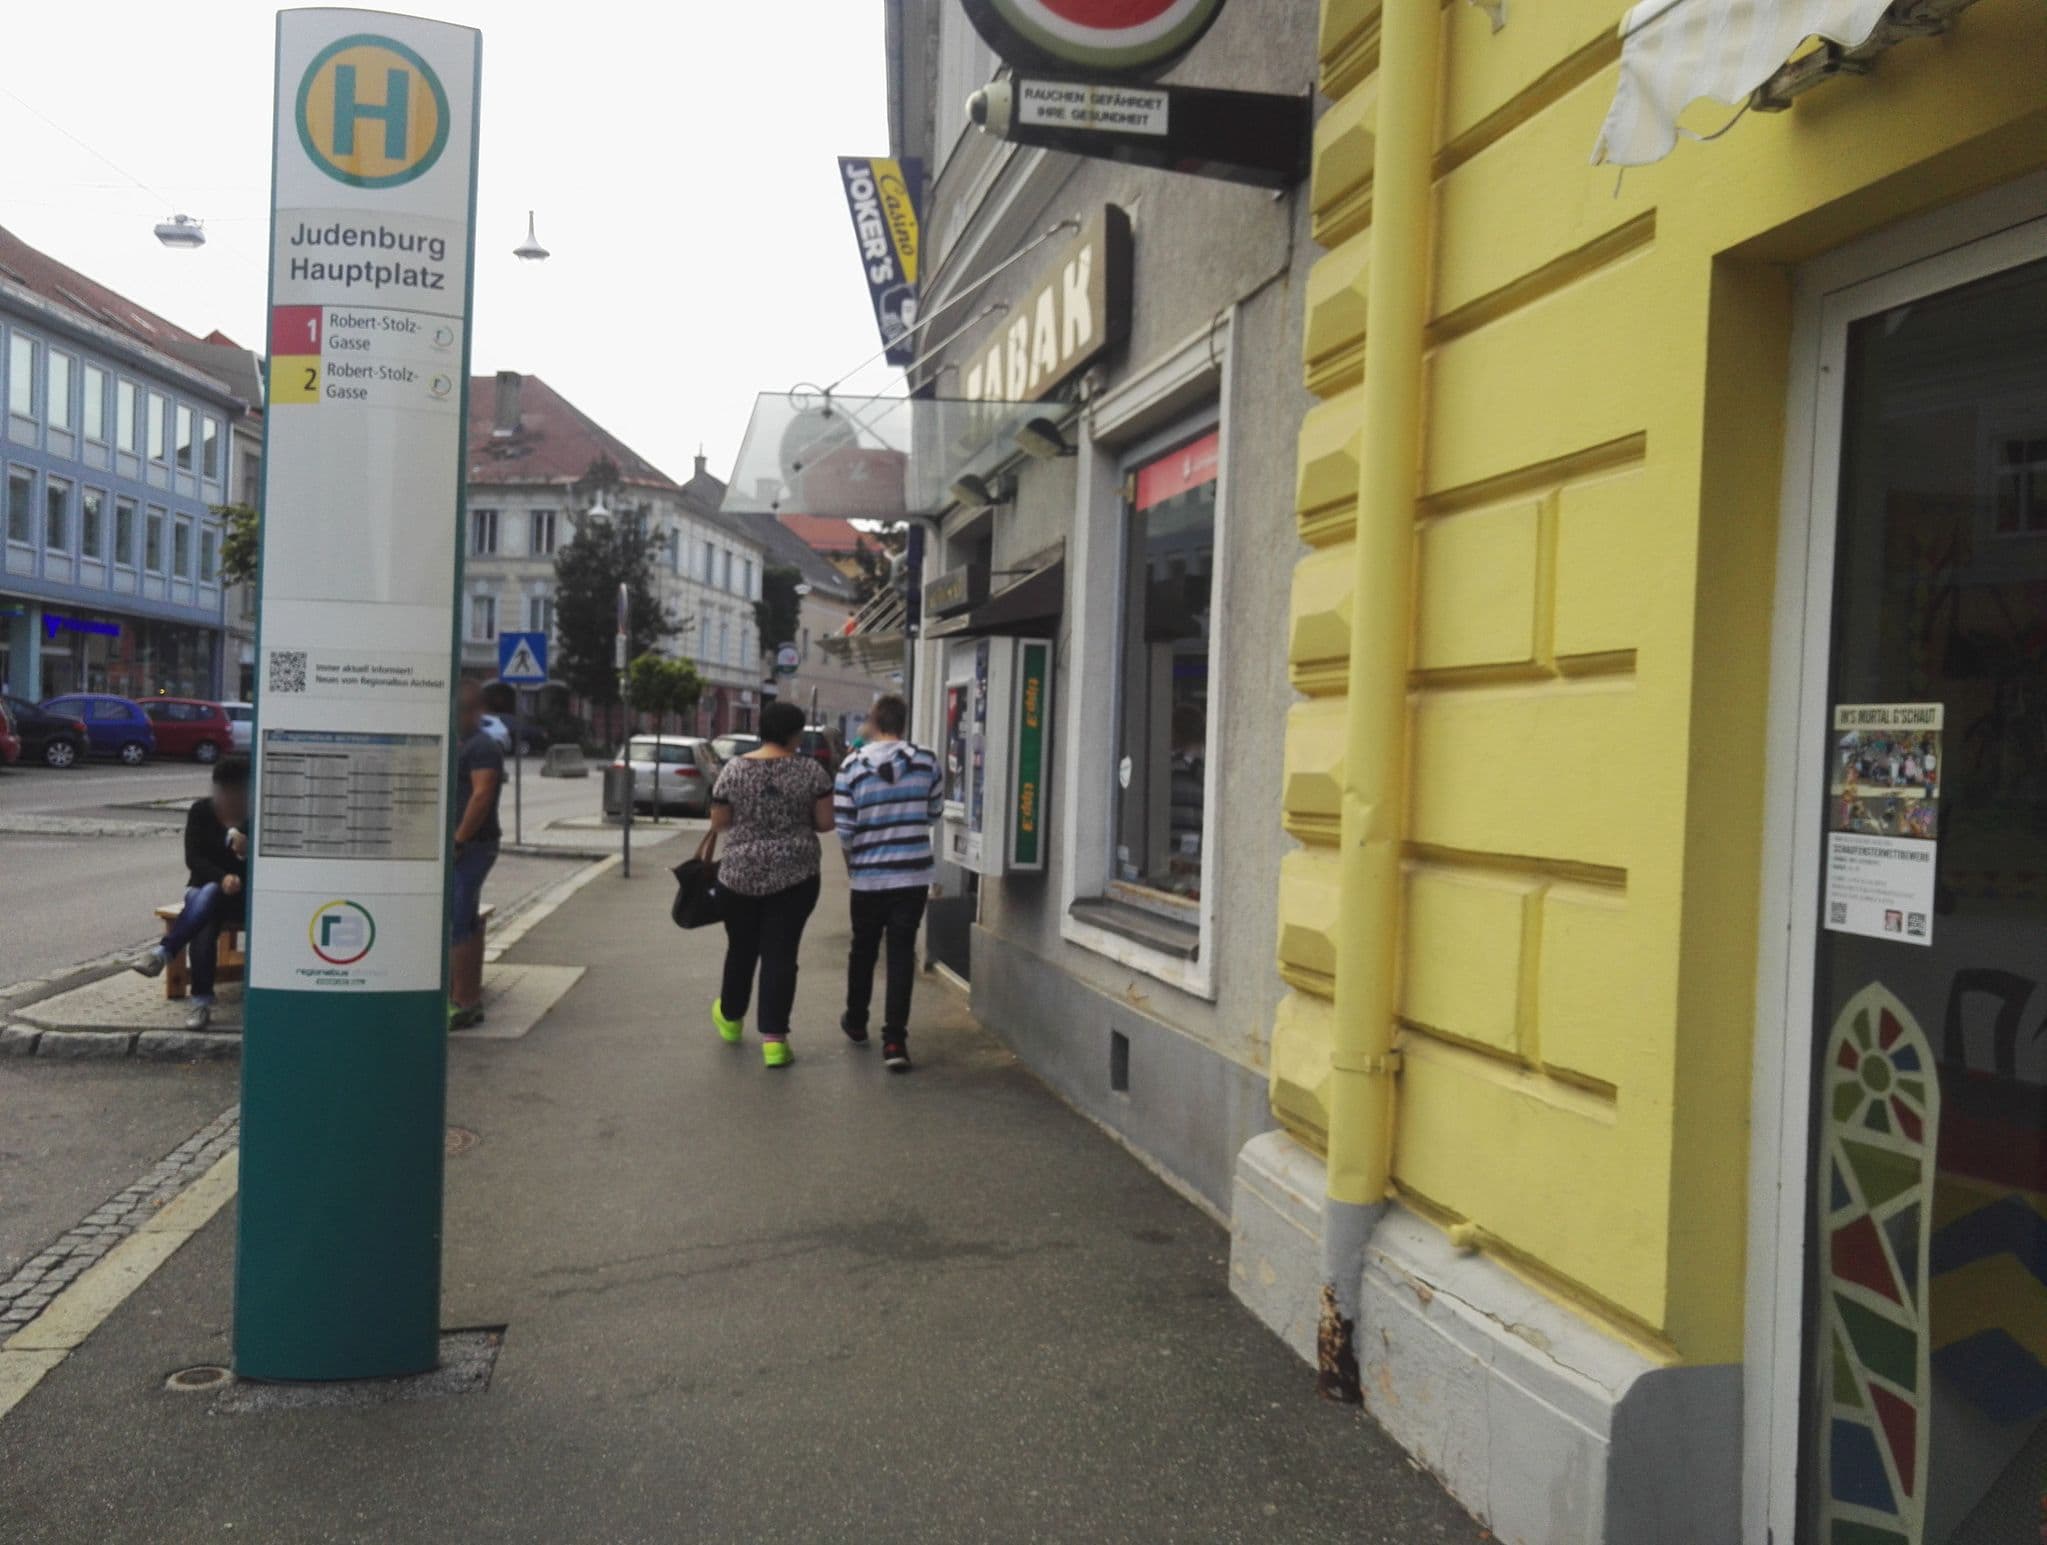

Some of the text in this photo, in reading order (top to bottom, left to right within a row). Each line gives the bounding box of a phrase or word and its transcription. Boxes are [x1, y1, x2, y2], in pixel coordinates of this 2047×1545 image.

[1023, 87, 1085, 103] RAUCHEN
[333, 64, 410, 161] H
[1036, 106, 1150, 126] IHRE GESUNDHEIT
[845, 163, 894, 285] JOKER'S
[879, 174, 915, 257] Casino
[290, 223, 446, 262] Judenburg
[290, 257, 445, 290] Hauptplatz
[306, 313, 422, 343] 1 Robert-Stolz-
[328, 335, 371, 351] Gasse
[303, 361, 420, 391] 2 Robert-Stolz-
[326, 384, 368, 400] Gasse
